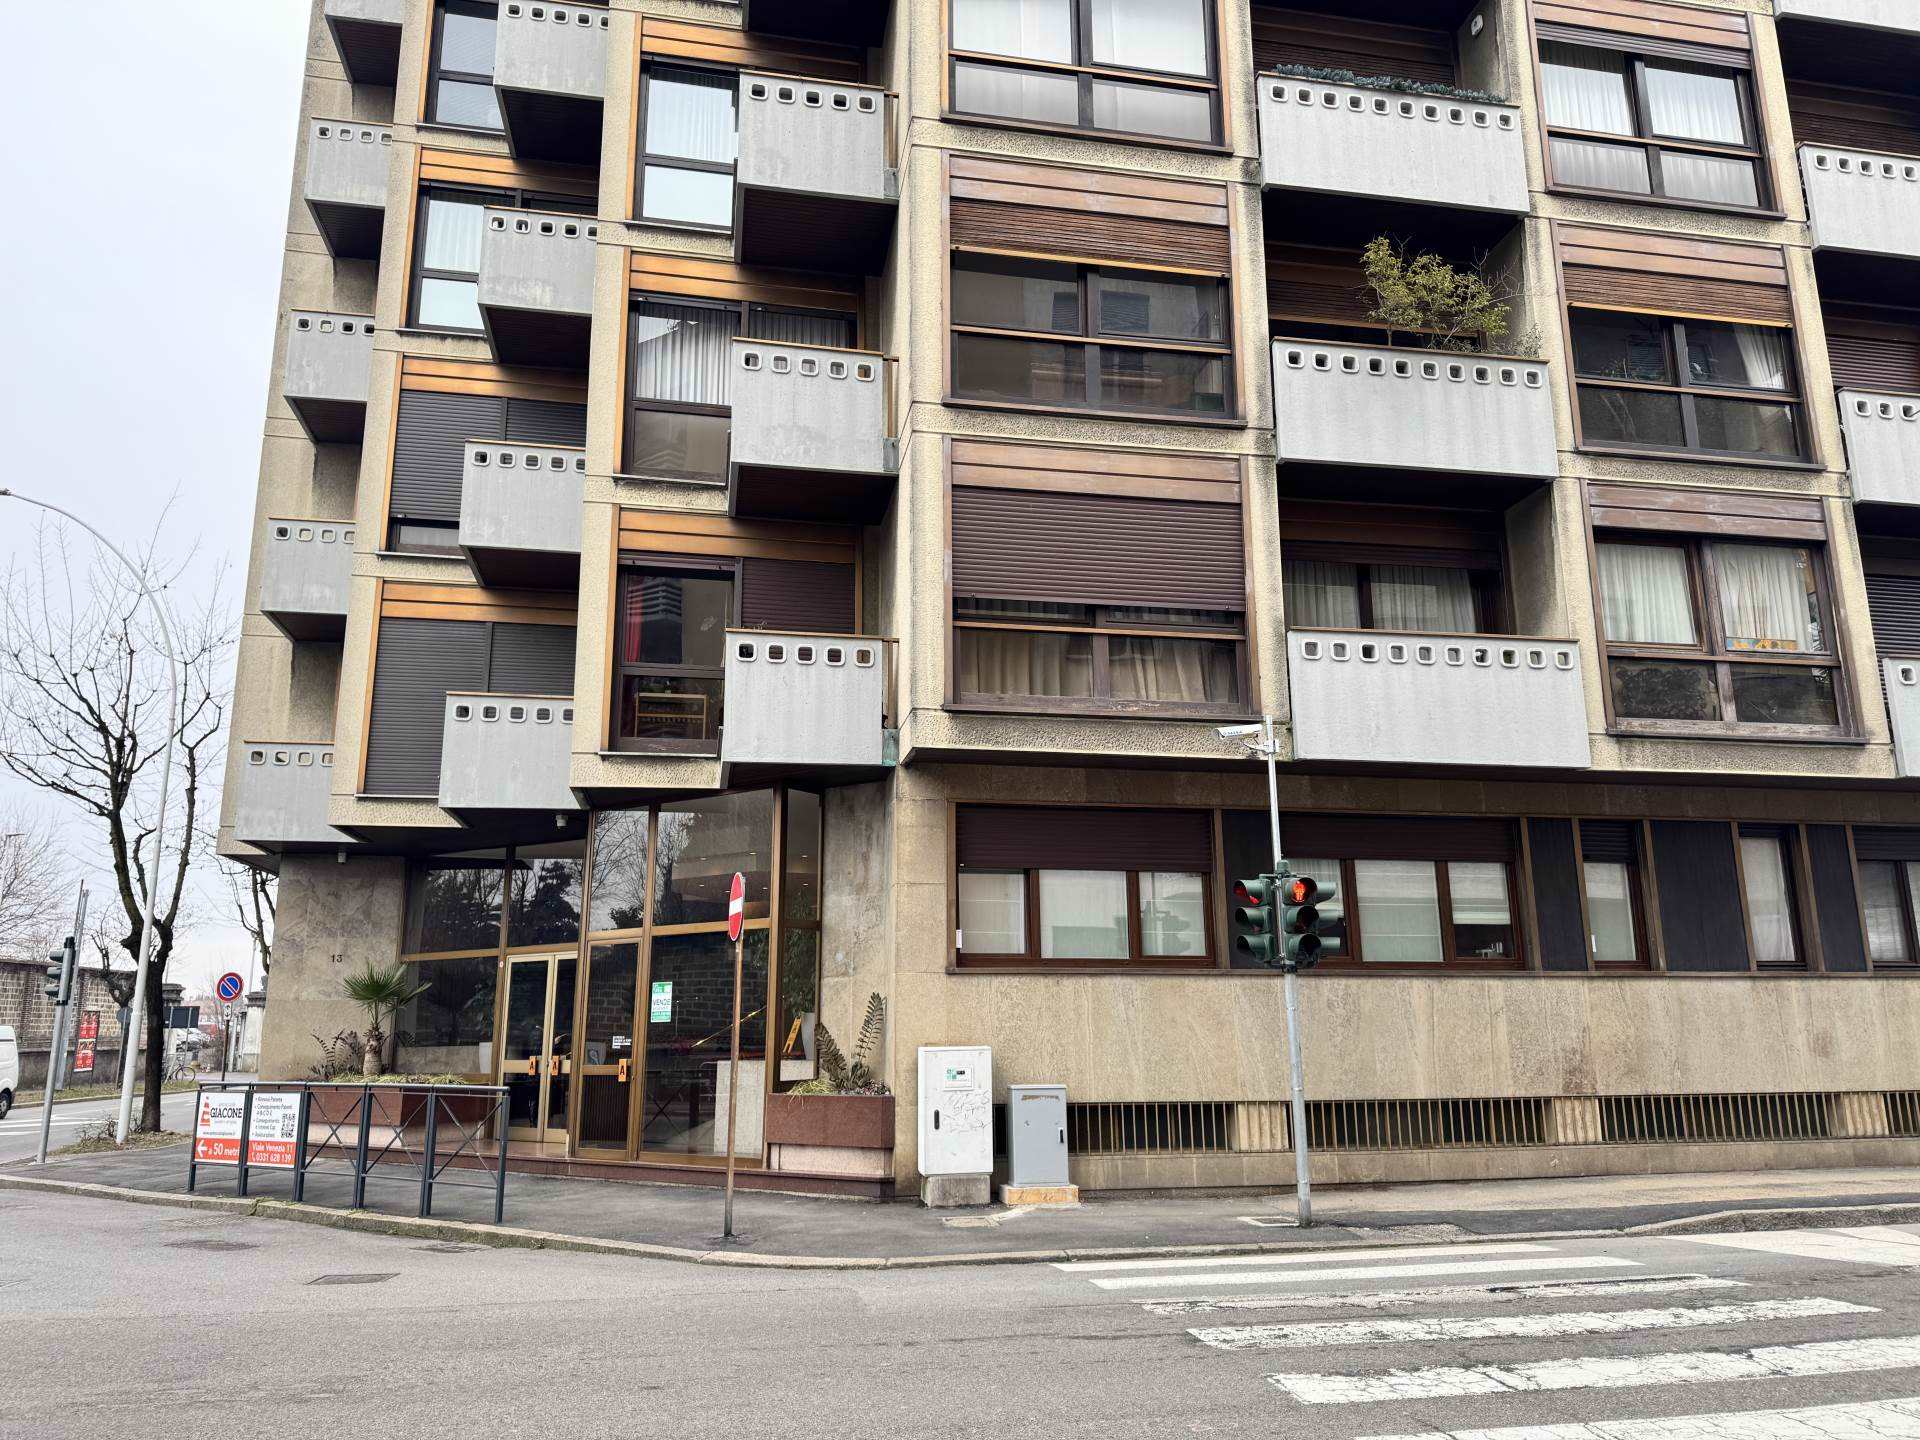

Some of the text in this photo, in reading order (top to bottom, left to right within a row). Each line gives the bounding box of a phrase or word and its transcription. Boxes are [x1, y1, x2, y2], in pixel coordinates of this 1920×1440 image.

[330, 954, 342, 963] 13
[620, 1066, 625, 1075] A
[210, 1107, 242, 1118] GIACONE
[213, 1143, 224, 1155] 50
[224, 1147, 240, 1156] metri
[252, 1142, 293, 1153] Viale Venezia 11
[256, 1152, 269, 1161] 0331
